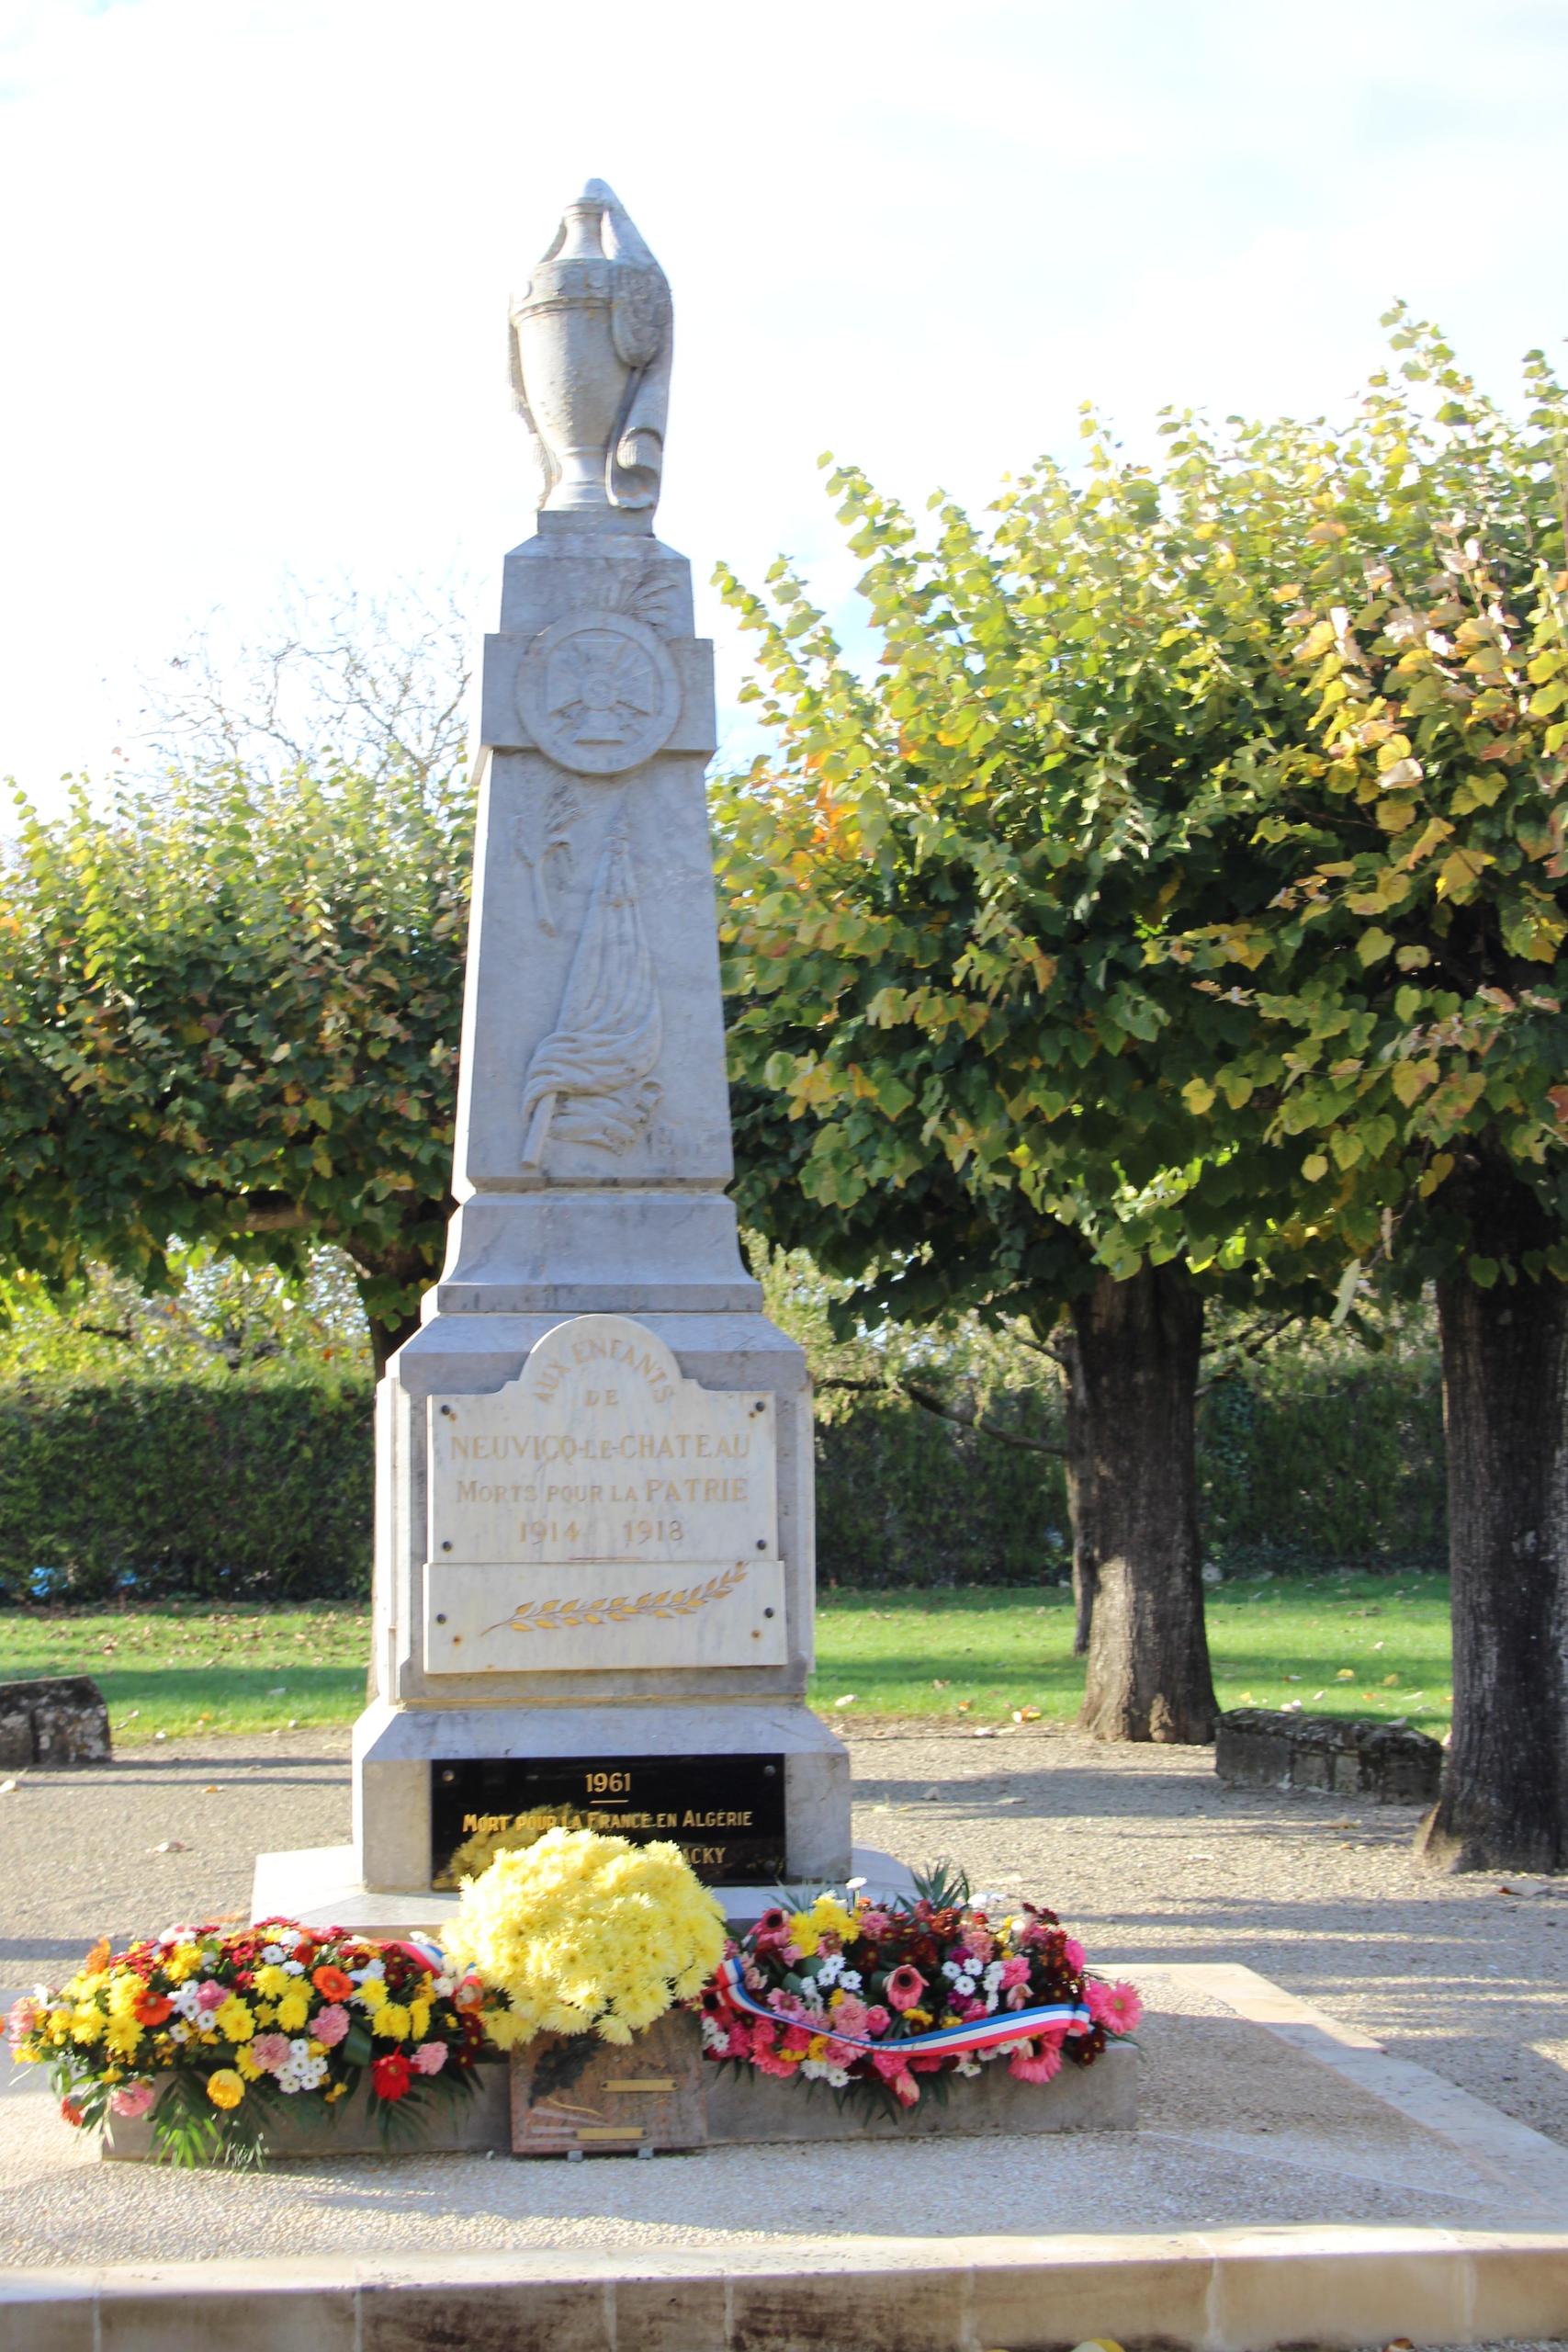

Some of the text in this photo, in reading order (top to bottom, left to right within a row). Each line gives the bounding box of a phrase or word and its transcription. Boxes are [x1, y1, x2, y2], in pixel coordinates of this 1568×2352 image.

[532, 1338, 676, 1404] AUX ENFANTS
[584, 1389, 619, 1408] DE
[457, 1477, 749, 1503] MORTS POUR LA PATRIE
[519, 1520, 684, 1545] 1914 1918
[585, 1771, 631, 1792] 1961
[462, 1808, 752, 1833] MORT POUR LA FRANCE EN ALGÉRIE
